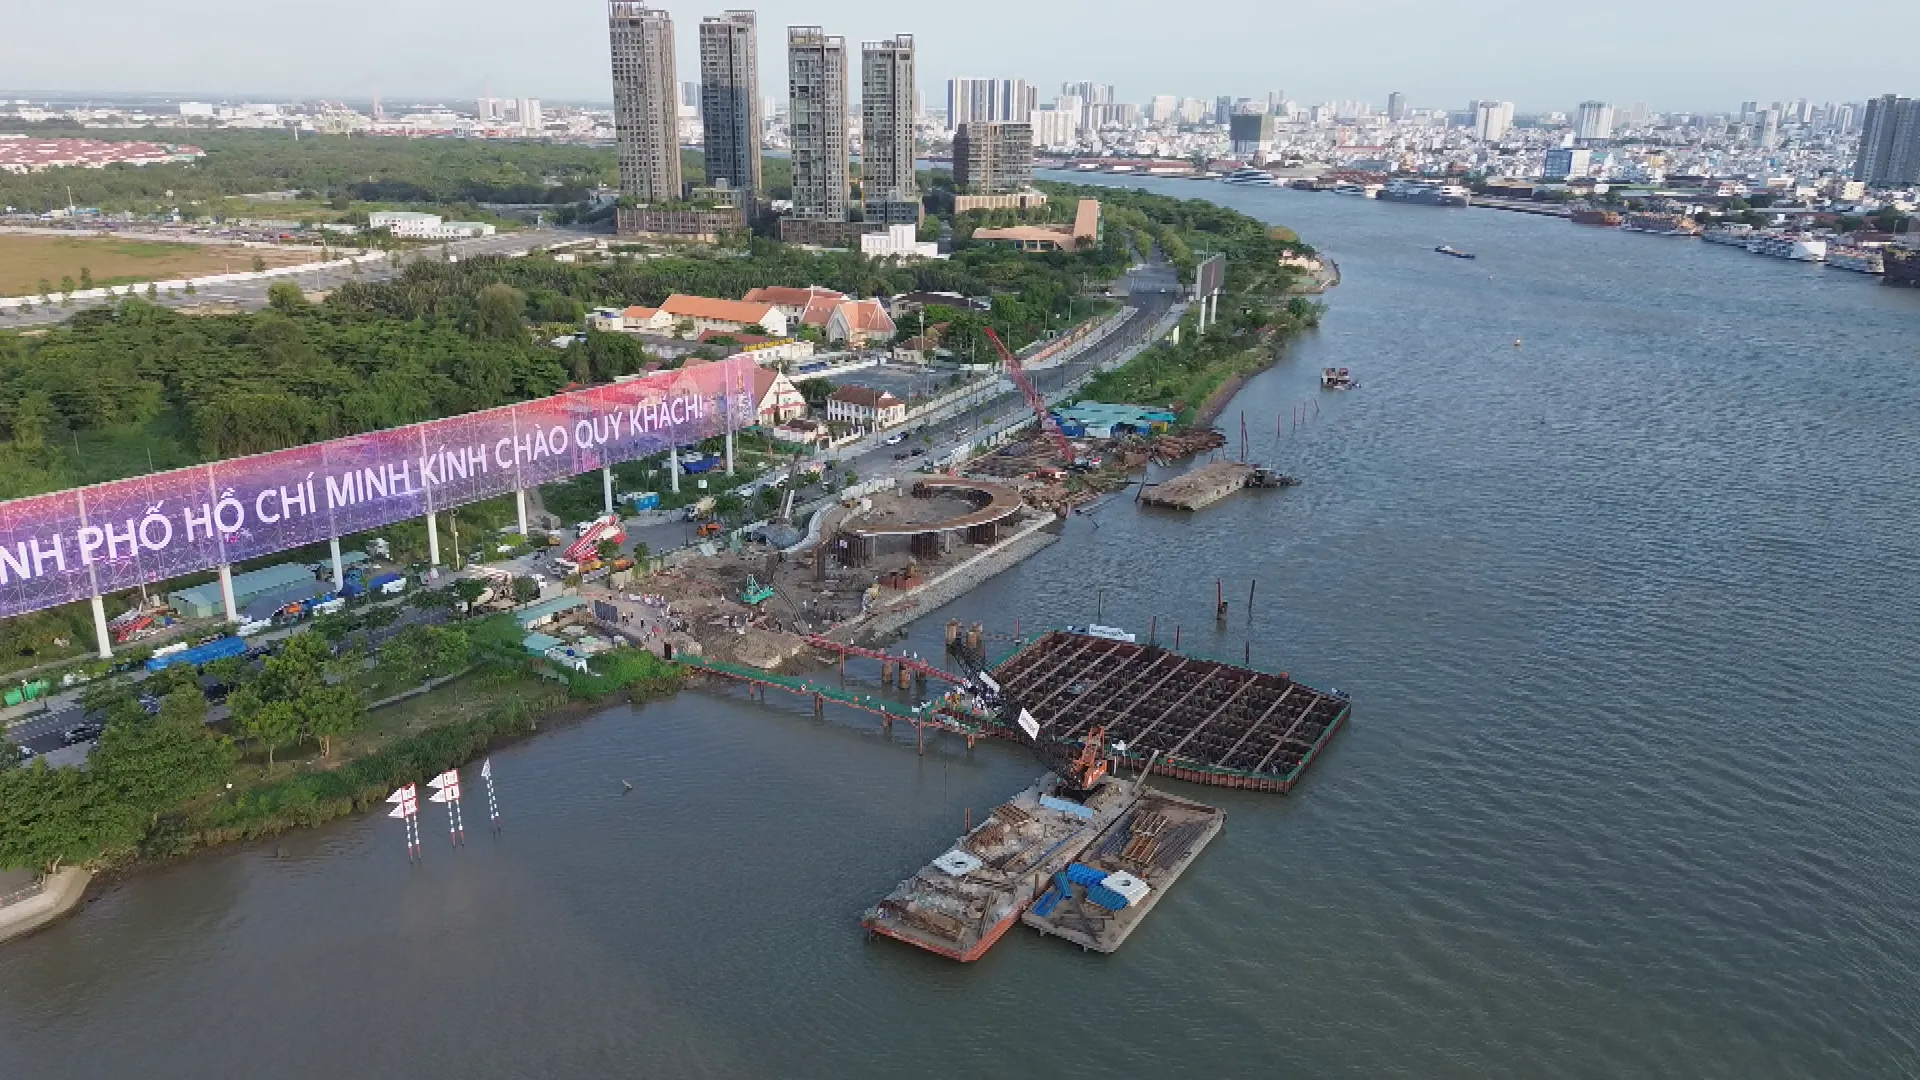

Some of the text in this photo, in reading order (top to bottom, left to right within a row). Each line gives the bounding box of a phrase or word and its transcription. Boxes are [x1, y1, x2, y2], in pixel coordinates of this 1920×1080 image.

[77, 500, 173, 566] PHỐ
[184, 487, 245, 542] HỒ
[256, 471, 317, 523] CHÍ
[326, 459, 411, 509] MINH
[419, 443, 488, 487] KÍNH
[495, 424, 568, 469] CHÀO
[575, 408, 623, 449] QUÝ
[629, 394, 703, 436] KHÁCH!
